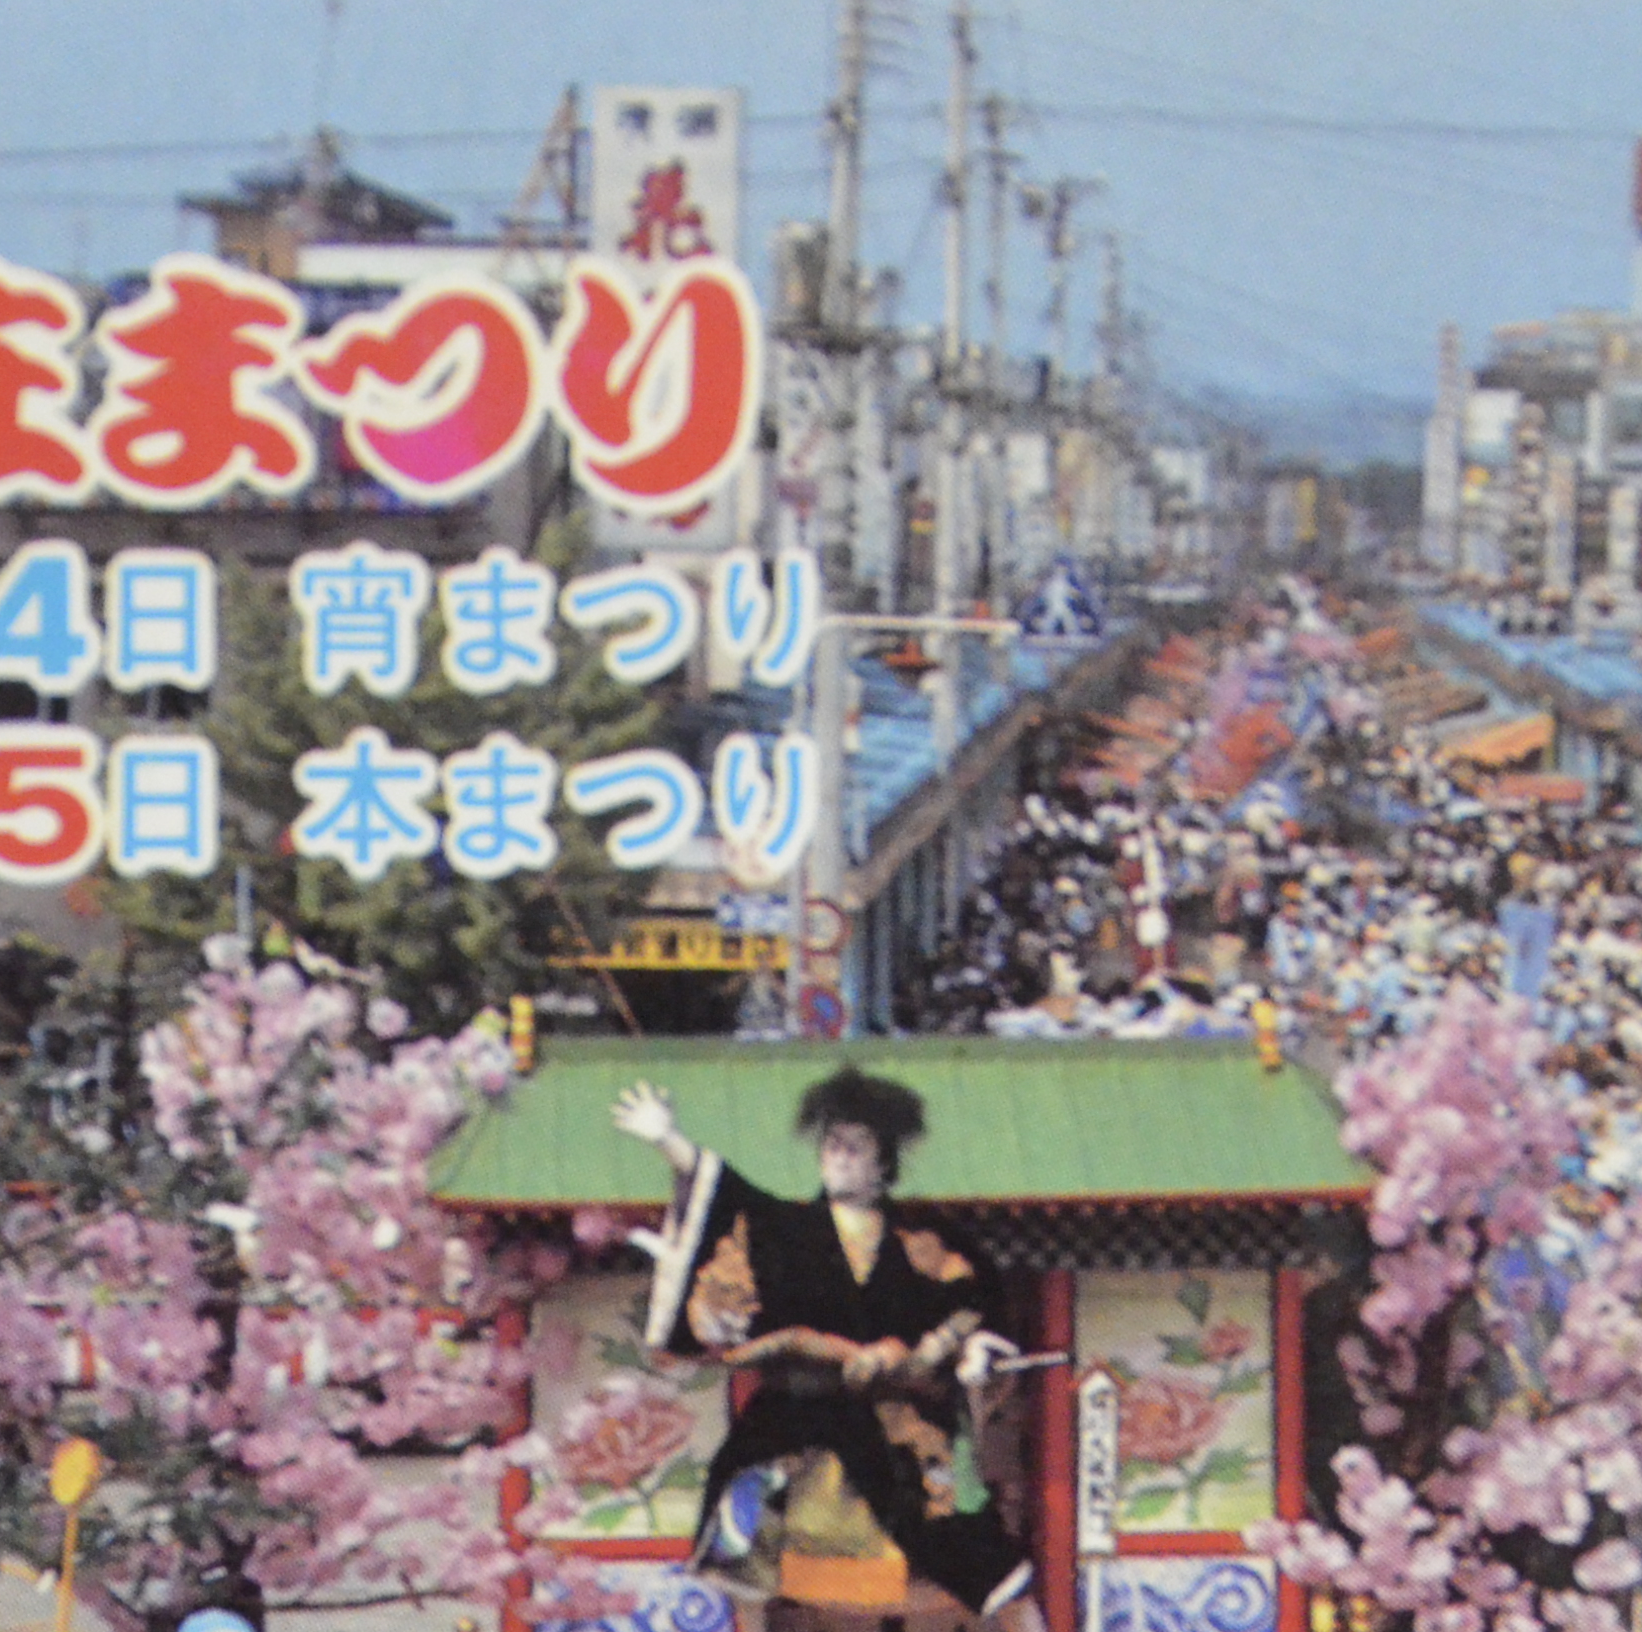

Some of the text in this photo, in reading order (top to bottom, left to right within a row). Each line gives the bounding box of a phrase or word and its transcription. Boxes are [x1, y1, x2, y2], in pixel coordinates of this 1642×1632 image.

[303, 556, 802, 677] 宵まつり
[304, 742, 803, 864] 本まつり
